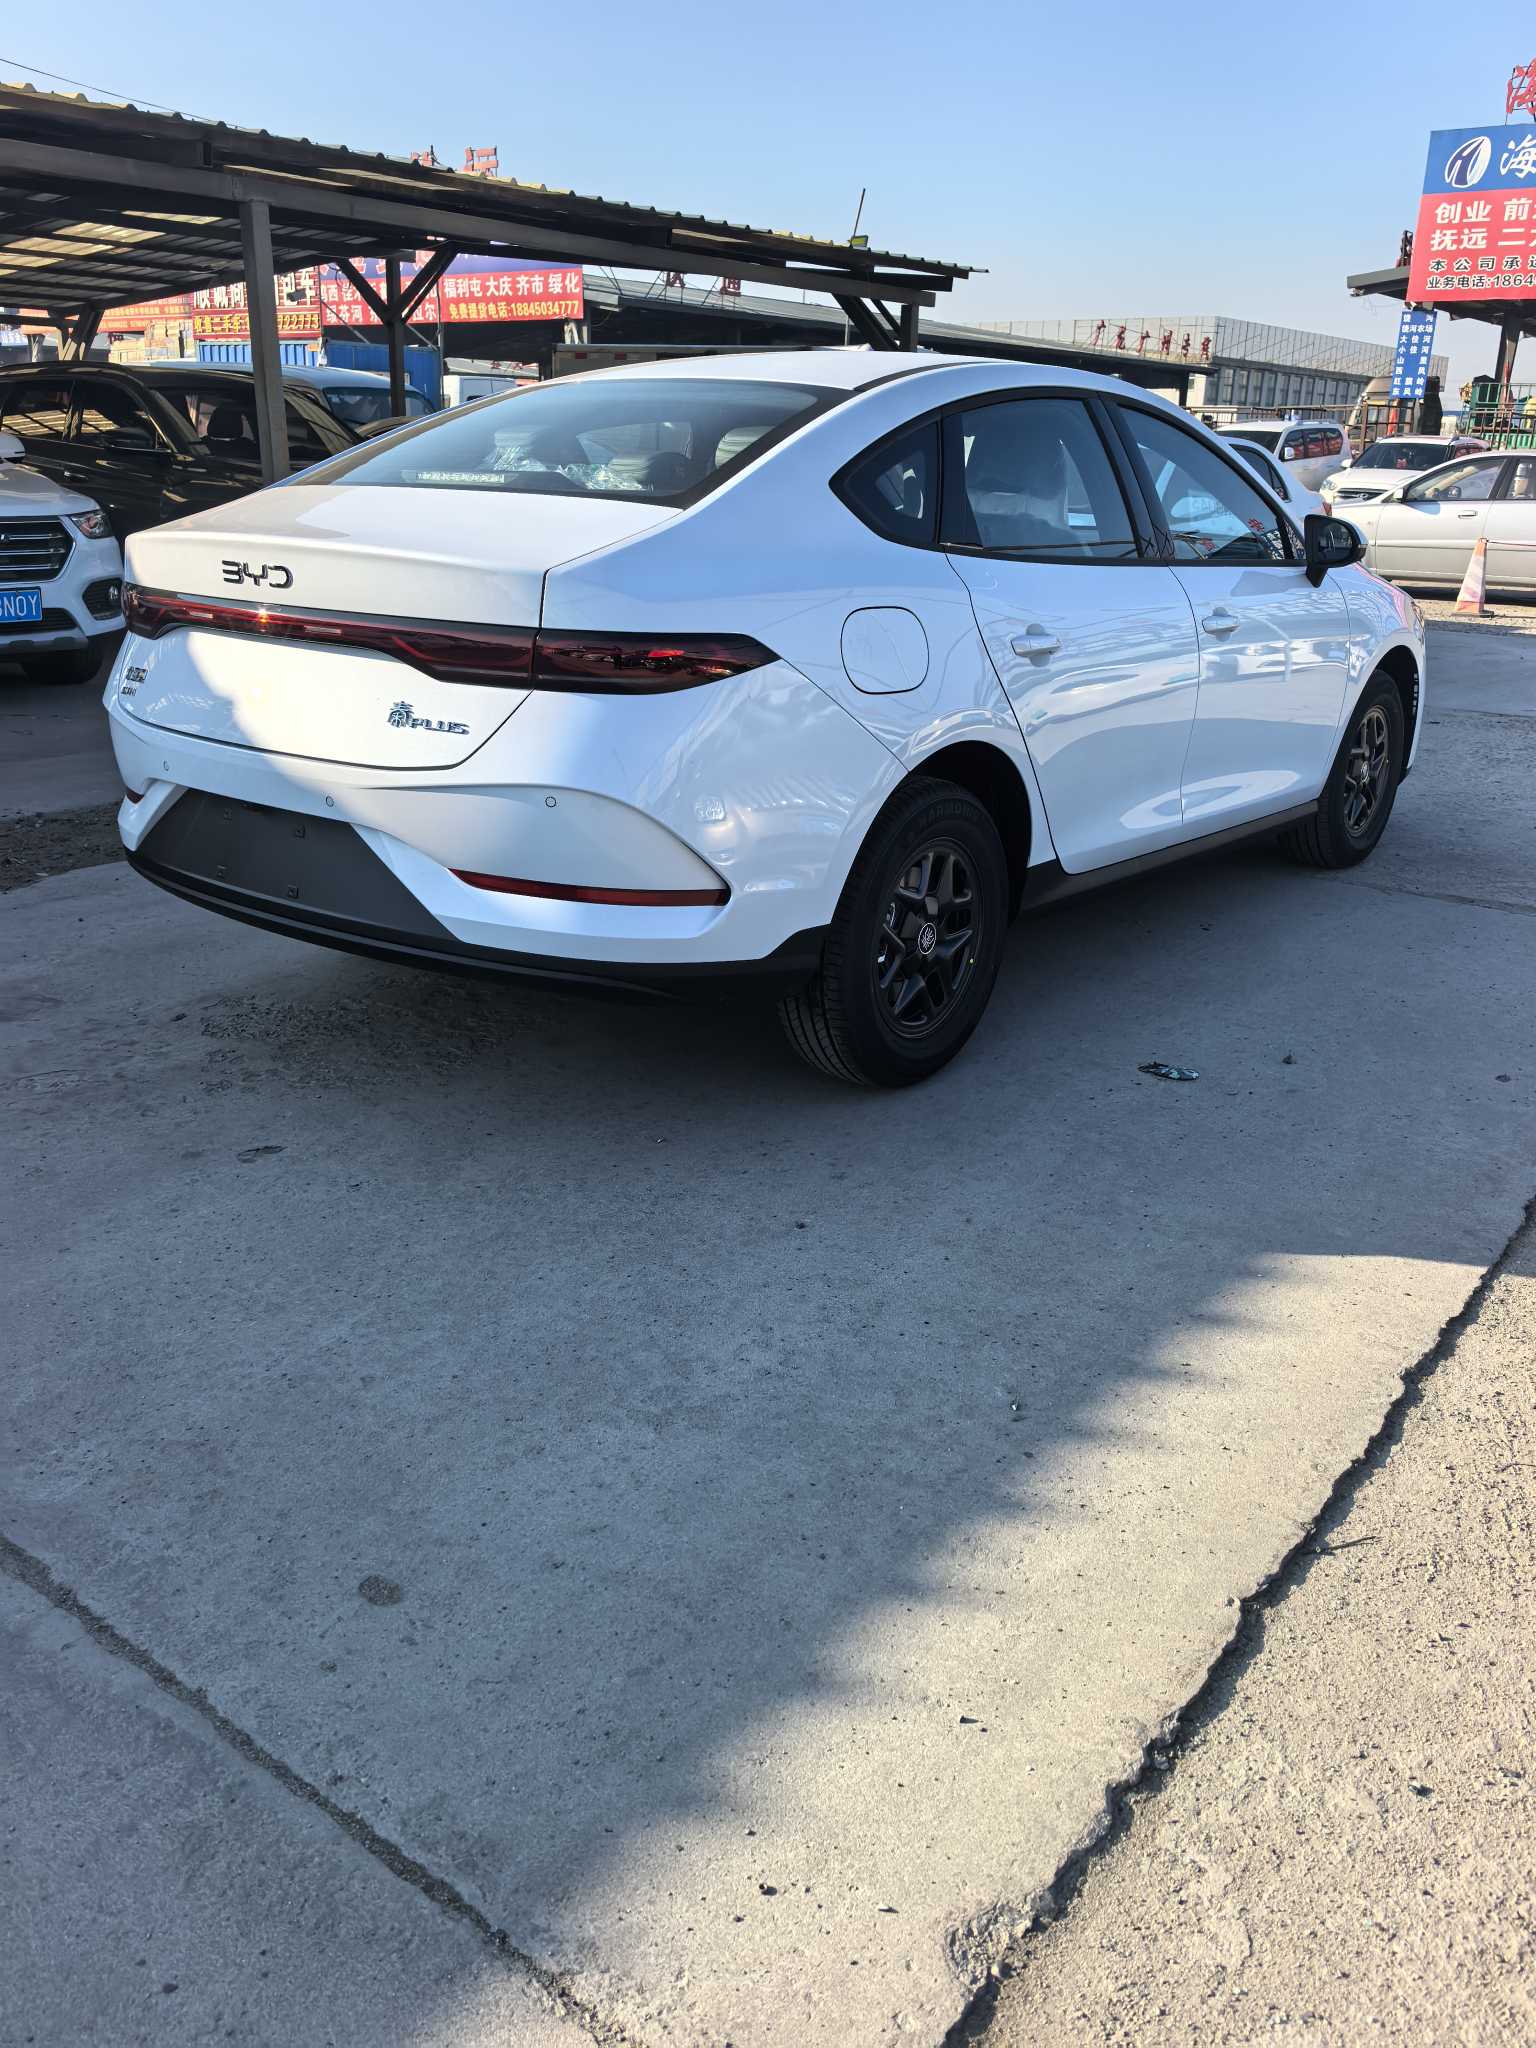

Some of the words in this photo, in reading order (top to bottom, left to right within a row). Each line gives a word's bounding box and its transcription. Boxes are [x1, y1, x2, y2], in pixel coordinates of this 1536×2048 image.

[1435, 200, 1492, 224] 创业
[1503, 197, 1536, 222] 前
[1430, 228, 1488, 251] 抚远
[444, 277, 483, 298] 福利屯
[485, 275, 513, 297] 大庆
[516, 274, 544, 295] 齐市
[548, 272, 580, 294] 绥化
[1426, 273, 1536, 290] 业务电话:1864
[222, 560, 294, 589] BYD
